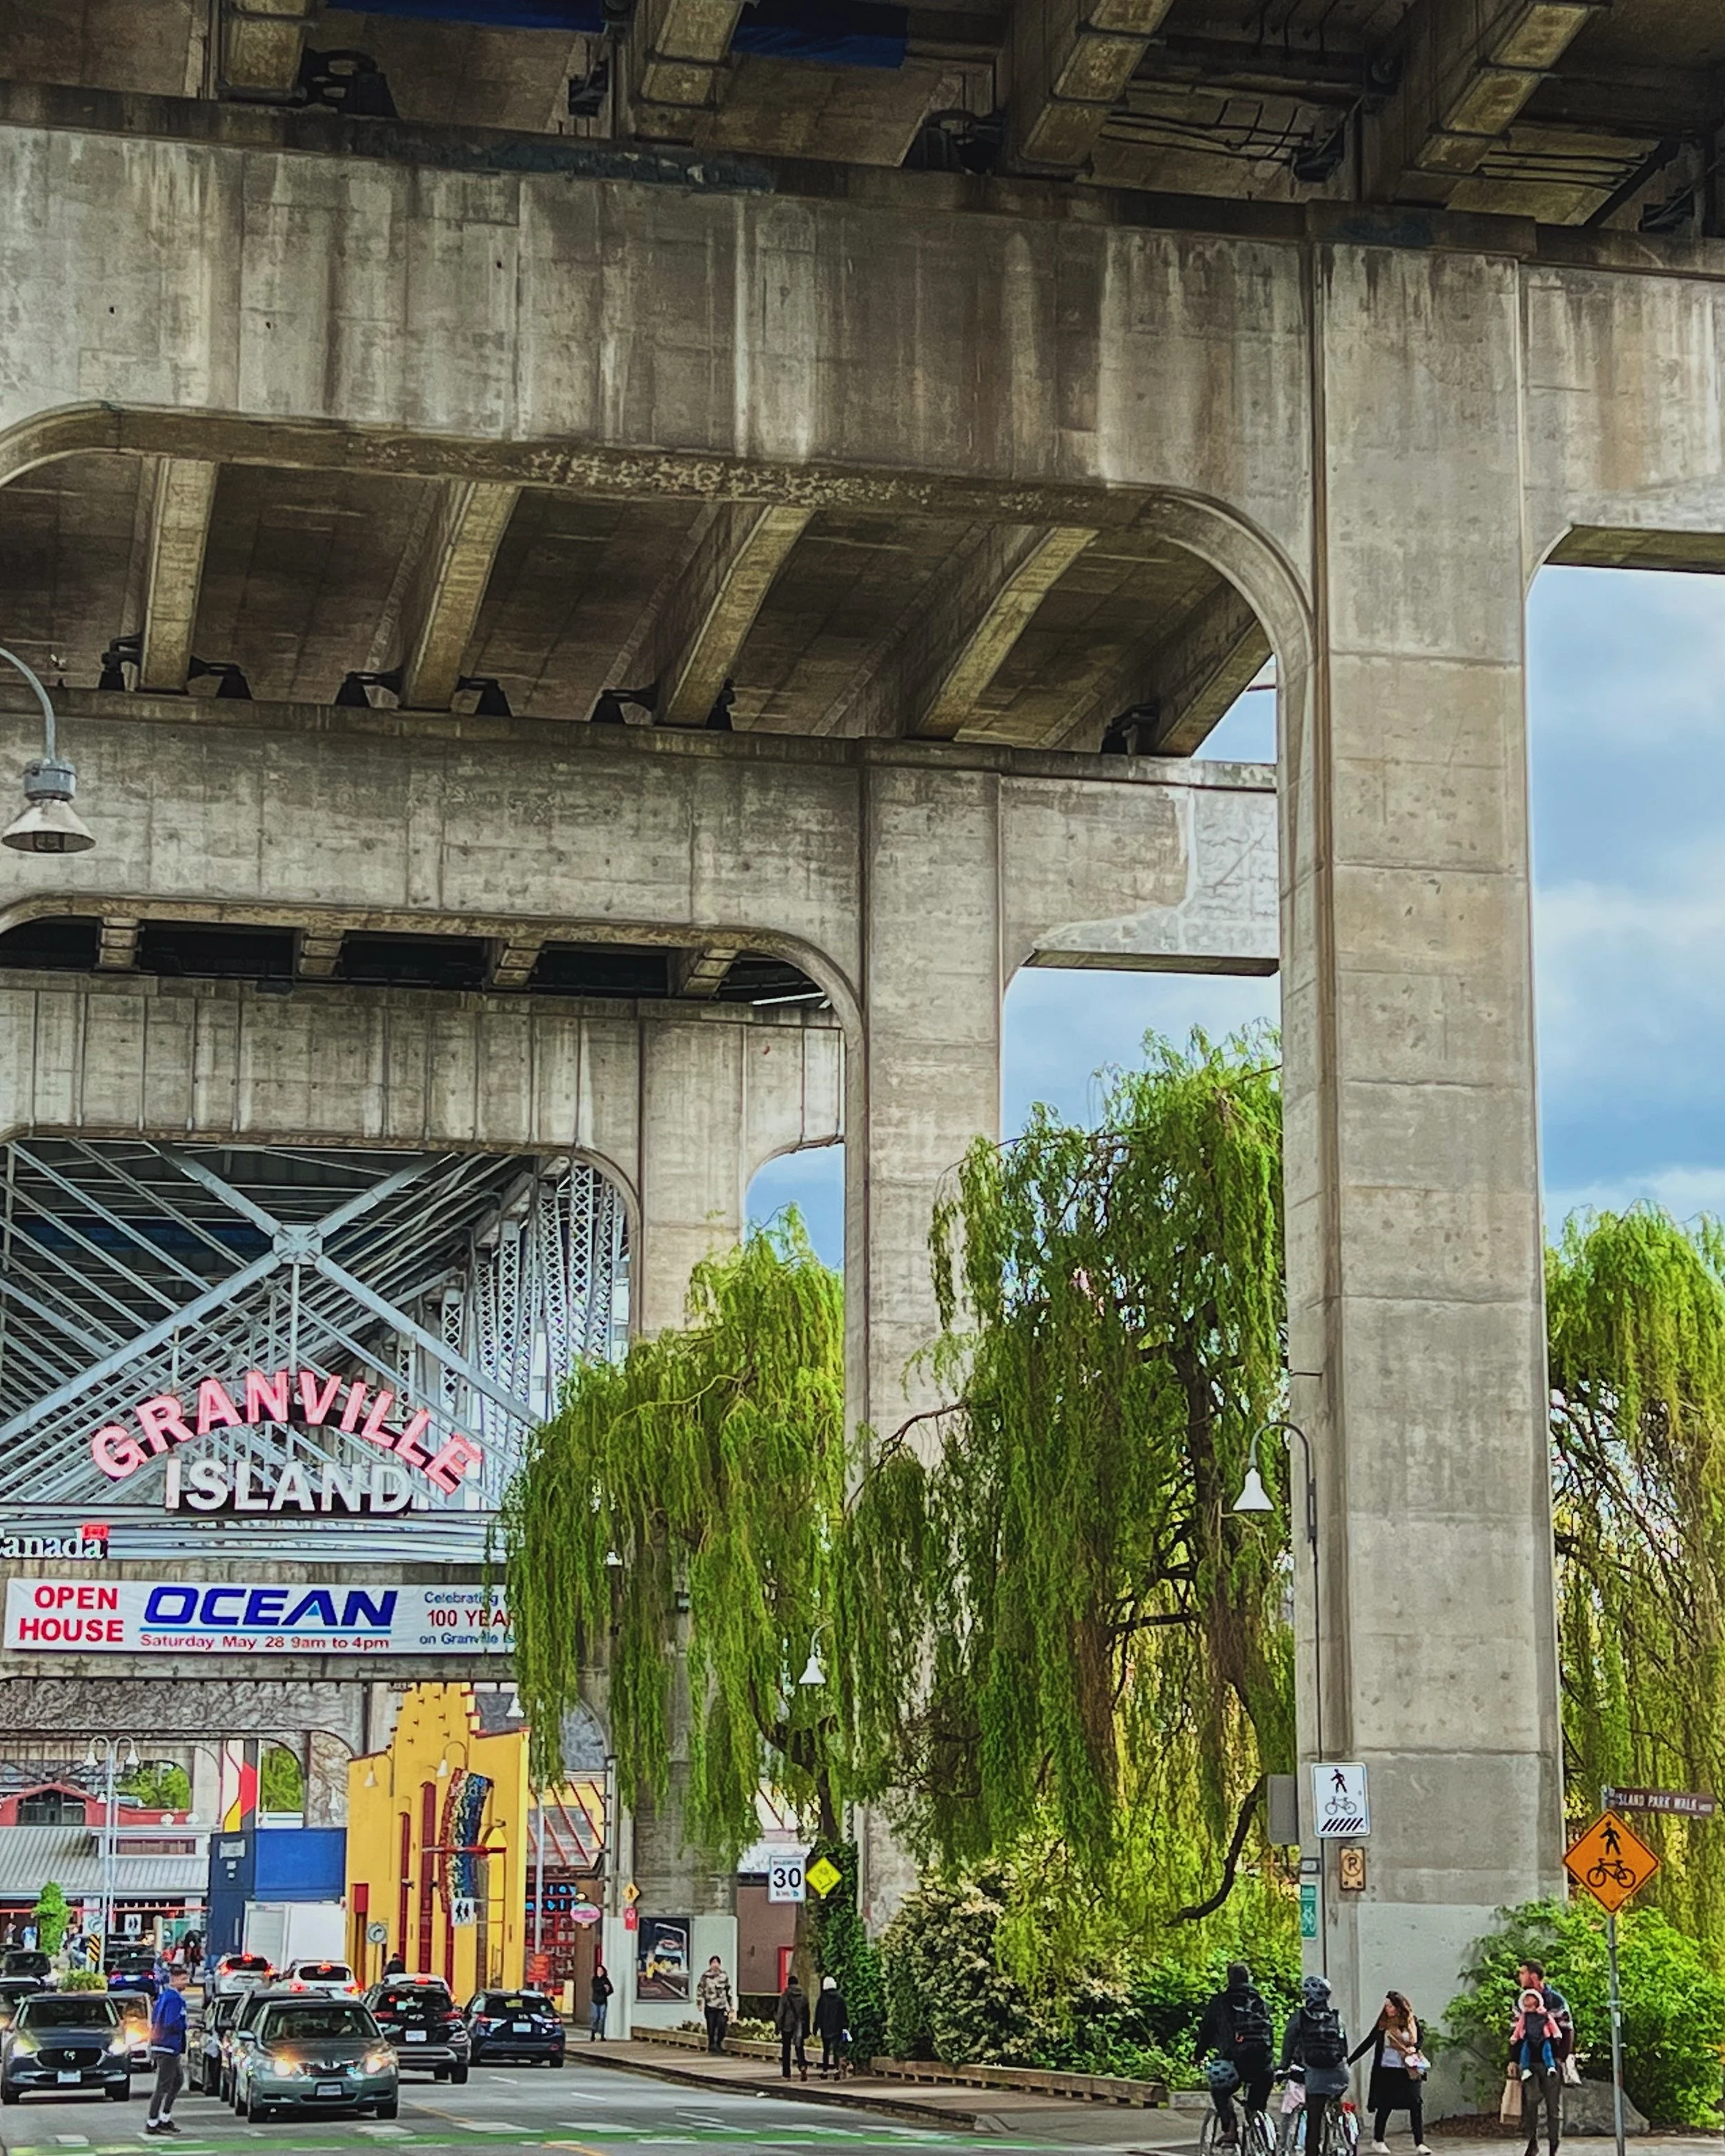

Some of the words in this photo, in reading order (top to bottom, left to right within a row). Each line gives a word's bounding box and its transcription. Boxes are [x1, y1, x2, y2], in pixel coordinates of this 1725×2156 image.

[90, 1369, 483, 1496] GRANVILLE
[165, 1458, 413, 1514] ISLAND
[34, 1585, 119, 1610] OPEN
[144, 1587, 399, 1627] OCEAN
[424, 1591, 499, 1607] Celebratig
[427, 1610, 457, 1627] 100
[19, 1617, 125, 1643] HOUSE
[419, 1635, 436, 1645] on
[140, 1634, 215, 1650] Saturday
[222, 1636, 258, 1650] May
[265, 1636, 285, 1648] 28
[290, 1636, 326, 1649] 9am
[332, 1637, 348, 1648] to
[351, 1637, 391, 1650] 4pm
[773, 1868, 801, 1888] 30
